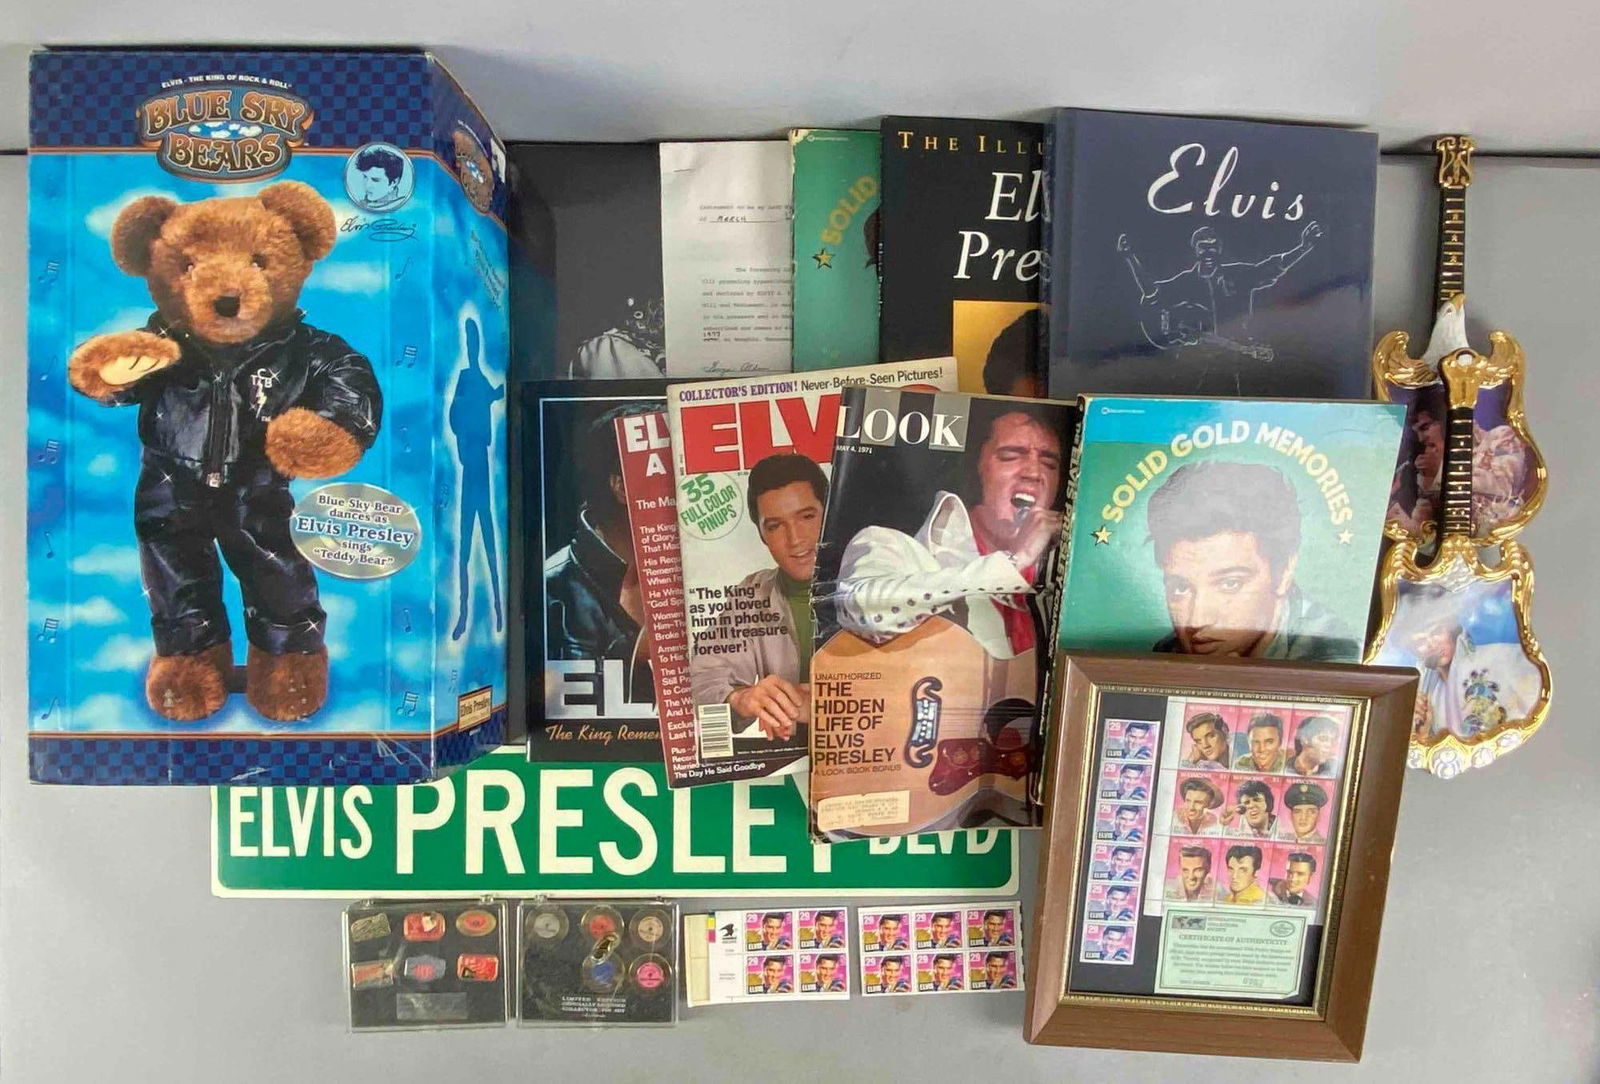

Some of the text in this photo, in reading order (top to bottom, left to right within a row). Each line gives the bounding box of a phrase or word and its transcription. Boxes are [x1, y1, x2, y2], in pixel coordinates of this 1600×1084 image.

[161, 79, 183, 88] ELVIS
[145, 90, 305, 135] BLUE SKY
[898, 131, 959, 150] THE
[168, 132, 282, 173] BEARS
[1146, 142, 1305, 222] Elvis
[821, 175, 878, 246] SOLID
[679, 385, 748, 401] COLLECTOR'S
[750, 381, 798, 395] EDITION!
[897, 367, 944, 382] Pictures!
[836, 405, 963, 448] LOOK
[858, 446, 872, 454] 1971
[646, 453, 667, 477] A
[1102, 420, 1353, 525] SOLID GOLD MEMORIES
[1065, 446, 1082, 500] ELVIS
[681, 473, 715, 503] 35
[318, 495, 402, 514] Blue Sky Bear
[636, 499, 656, 510] The
[680, 485, 737, 526] FULL COLOR
[329, 508, 388, 523] dances as
[698, 504, 737, 535] PINUPS
[297, 517, 413, 548] Elvis Presley
[639, 526, 655, 534] The
[341, 540, 372, 553] sings
[642, 545, 662, 553] That
[1055, 502, 1073, 590] PRESLEY
[644, 558, 658, 567] His
[647, 577, 671, 586] When
[649, 591, 662, 599] He
[689, 584, 761, 600] “The King”
[689, 597, 771, 615] as you loved
[691, 611, 780, 627] him in photos
[692, 625, 788, 643] you'll treasure
[693, 640, 747, 656] forever!
[658, 655, 669, 663] To
[660, 668, 676, 676] The
[815, 672, 882, 680] UNAUTHORIZED
[815, 682, 852, 697] THE
[663, 699, 680, 707] The
[815, 699, 885, 714] HIDDEN
[666, 708, 683, 718] And
[815, 715, 883, 732] LIFE OF
[545, 725, 572, 741] The
[578, 725, 613, 746] King
[669, 731, 687, 740] Last
[815, 733, 864, 749] ELVIS
[815, 747, 896, 766] PRESLEY
[689, 769, 704, 778] Day
[705, 767, 715, 775] He
[716, 765, 732, 774] Said
[733, 761, 766, 772] Goodbye
[846, 767, 871, 775] BOOK
[872, 765, 901, 773] BONUS
[230, 785, 373, 859] ELVIS
[747, 913, 758, 923] 29
[800, 911, 810, 921] 29
[863, 915, 874, 924] 29
[915, 913, 926, 922] 29
[968, 911, 979, 920] 29
[747, 957, 759, 966] 29
[800, 954, 811, 964] 29
[865, 957, 876, 966] 29
[917, 954, 928, 963] 29
[970, 952, 981, 961] 29
